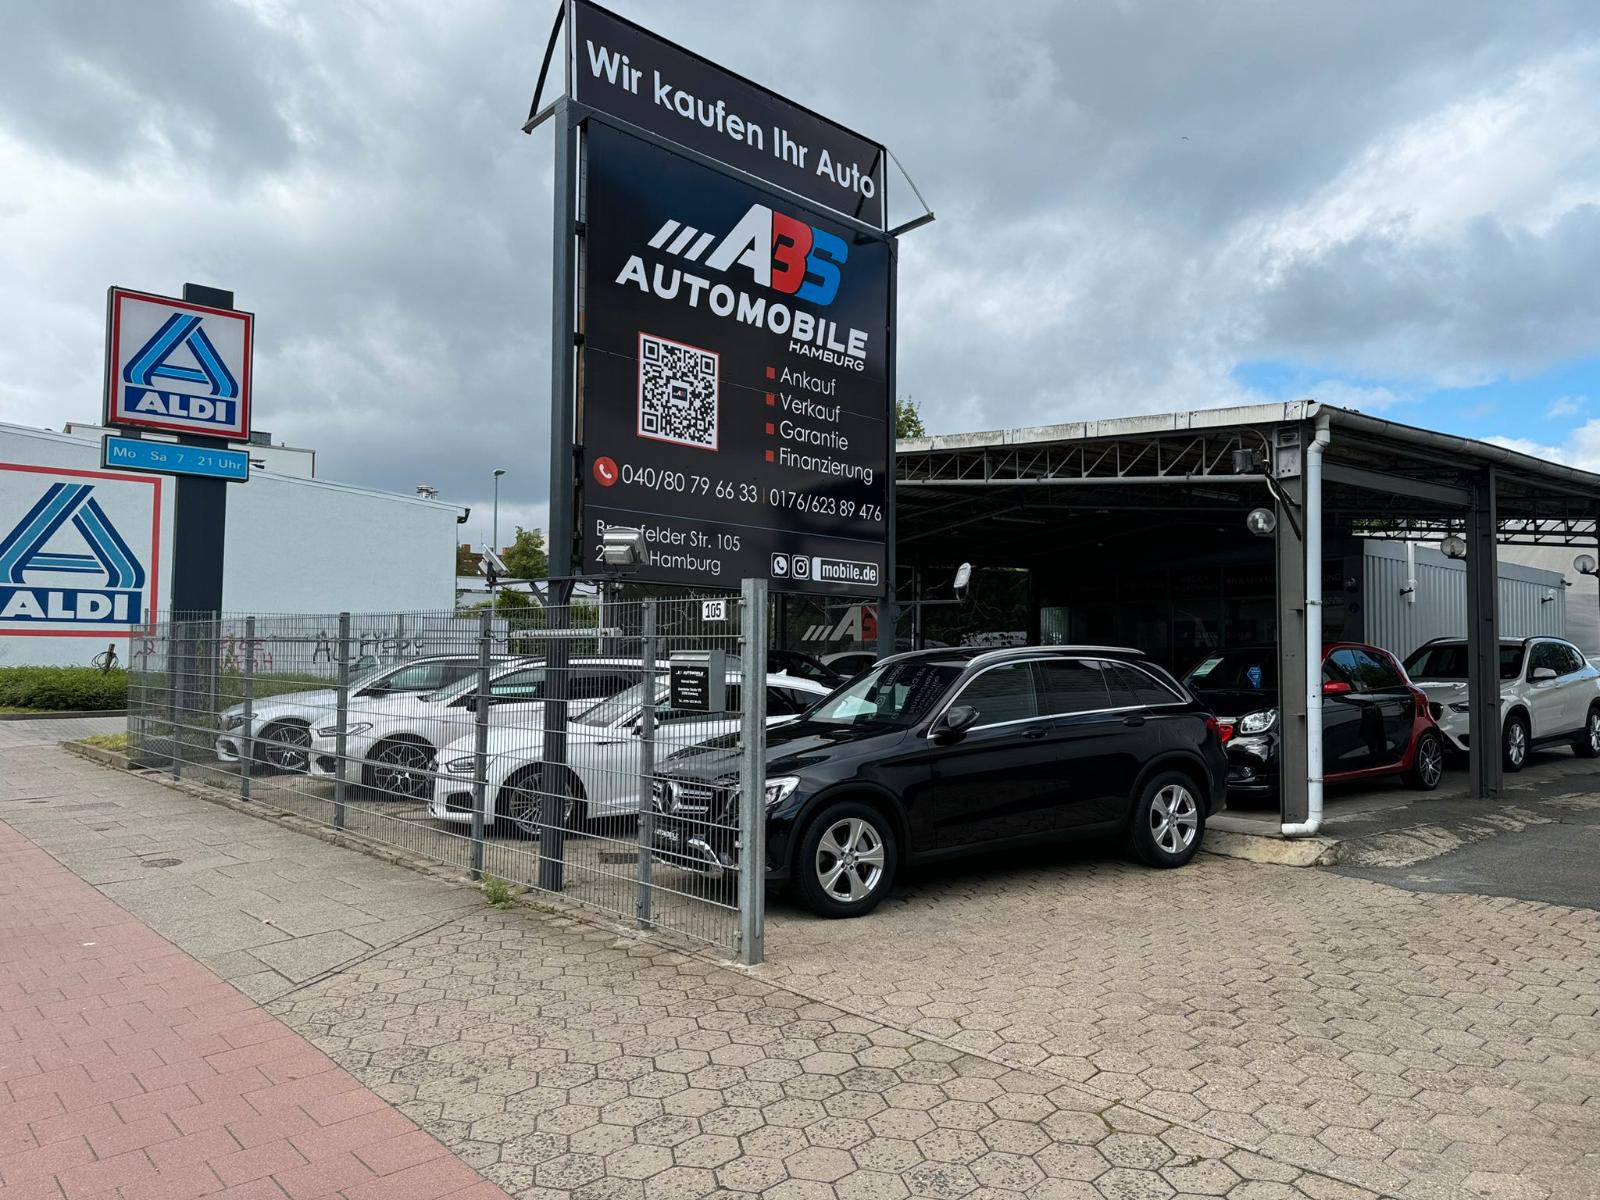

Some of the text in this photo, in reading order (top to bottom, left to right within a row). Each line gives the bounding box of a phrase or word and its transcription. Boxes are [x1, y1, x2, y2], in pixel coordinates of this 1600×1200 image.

[586, 39, 876, 199] Wir kaufen Ihr Auto
[615, 254, 869, 360] AUTOMOBILE
[788, 341, 865, 372] HAMBURG
[780, 366, 836, 396] Ankauf
[135, 391, 227, 423] ALDI
[780, 392, 841, 423] Verkauf
[780, 420, 849, 451] Garantie
[113, 446, 242, 471] Mo Sa 7 21 Uhr
[780, 447, 873, 485] Finanzierung
[621, 464, 758, 503] 040/80 79 66 33
[769, 488, 882, 522] 0176/623 89 476
[690, 530, 712, 549] Str.
[717, 533, 741, 552] 105
[650, 549, 722, 576] Hamburg
[821, 563, 877, 582] mobile.de
[0, 590, 129, 621] ALDI
[705, 602, 722, 619] 105
